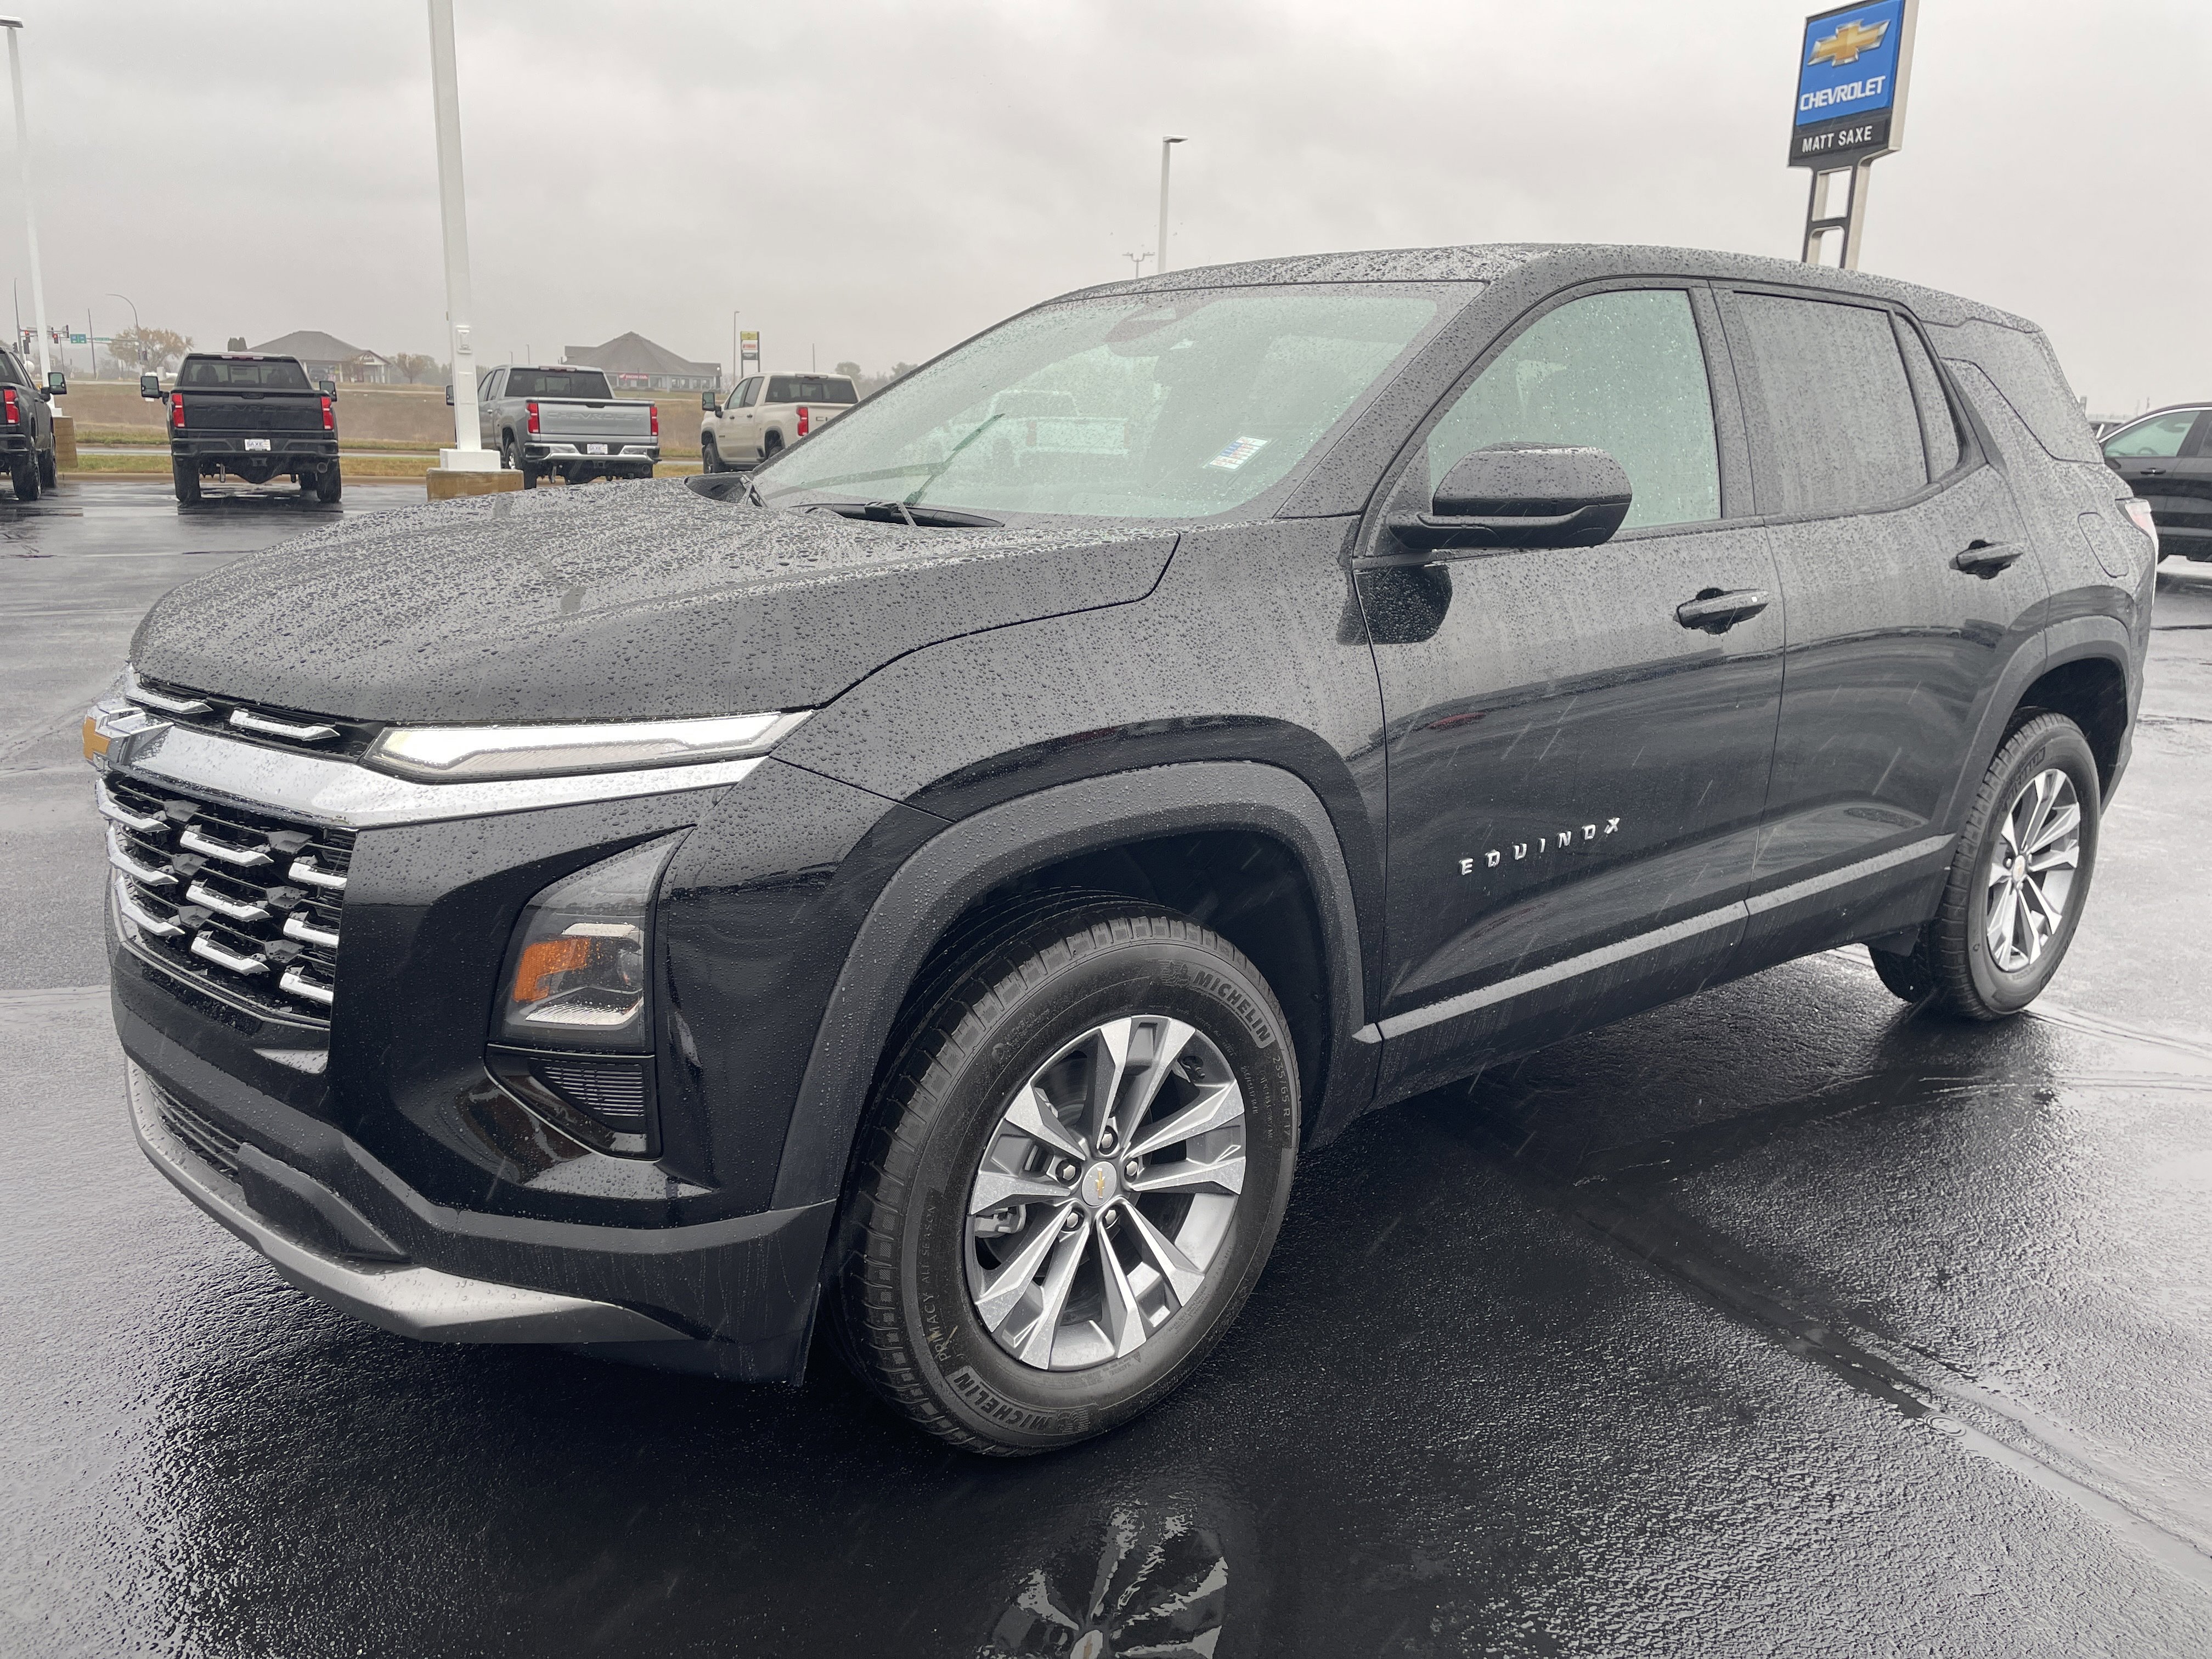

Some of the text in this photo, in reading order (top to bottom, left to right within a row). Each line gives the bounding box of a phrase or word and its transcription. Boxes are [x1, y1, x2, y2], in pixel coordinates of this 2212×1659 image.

[1799, 75, 1887, 111] CHEVROLET
[1802, 126, 1872, 153] MATT SAXE
[1459, 817, 1620, 876] EQUINOX
[1193, 969, 1271, 1042] MICHELIN
[923, 1292, 951, 1362] PRIMACY
[953, 1372, 1050, 1430] MICHELIN
